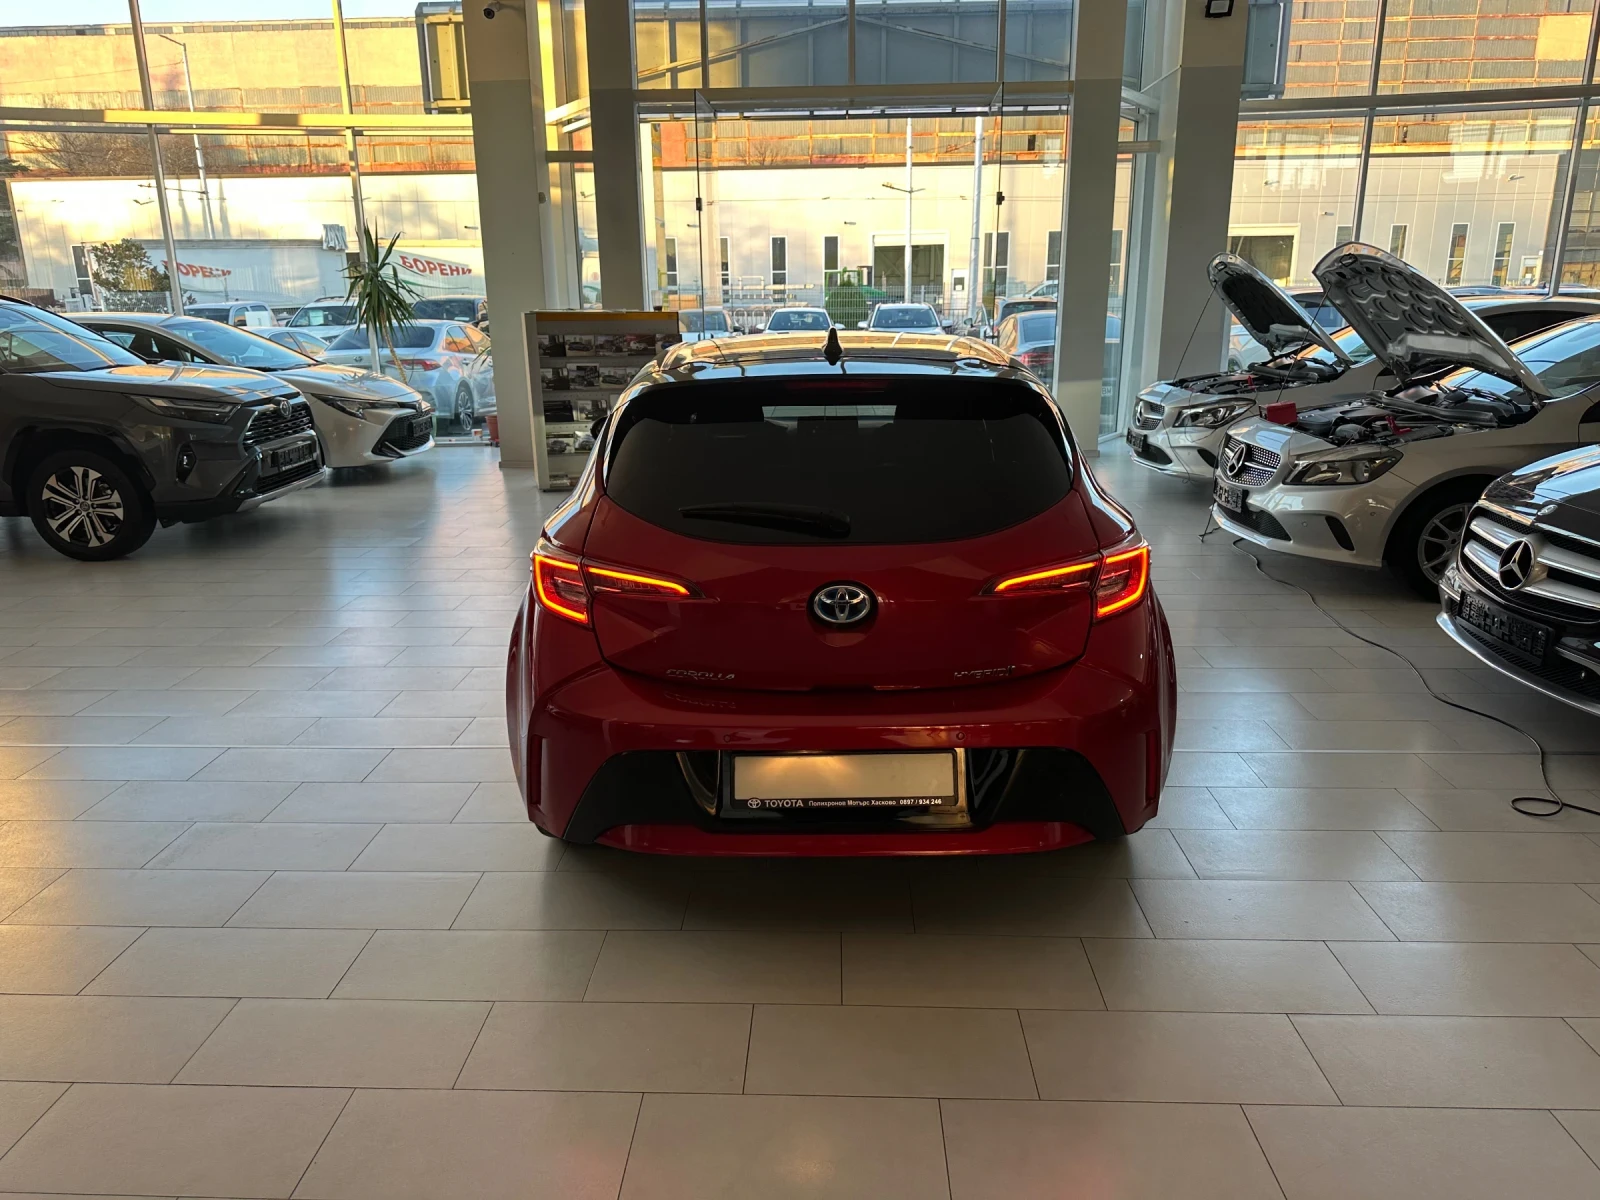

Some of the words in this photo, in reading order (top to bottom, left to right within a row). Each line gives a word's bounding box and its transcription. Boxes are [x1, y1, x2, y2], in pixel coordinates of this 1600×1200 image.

[399, 255, 472, 276] БОРЕНИ
[665, 668, 736, 680] COROLLA
[764, 799, 804, 808] TOYOTA
[918, 798, 930, 806] 934
